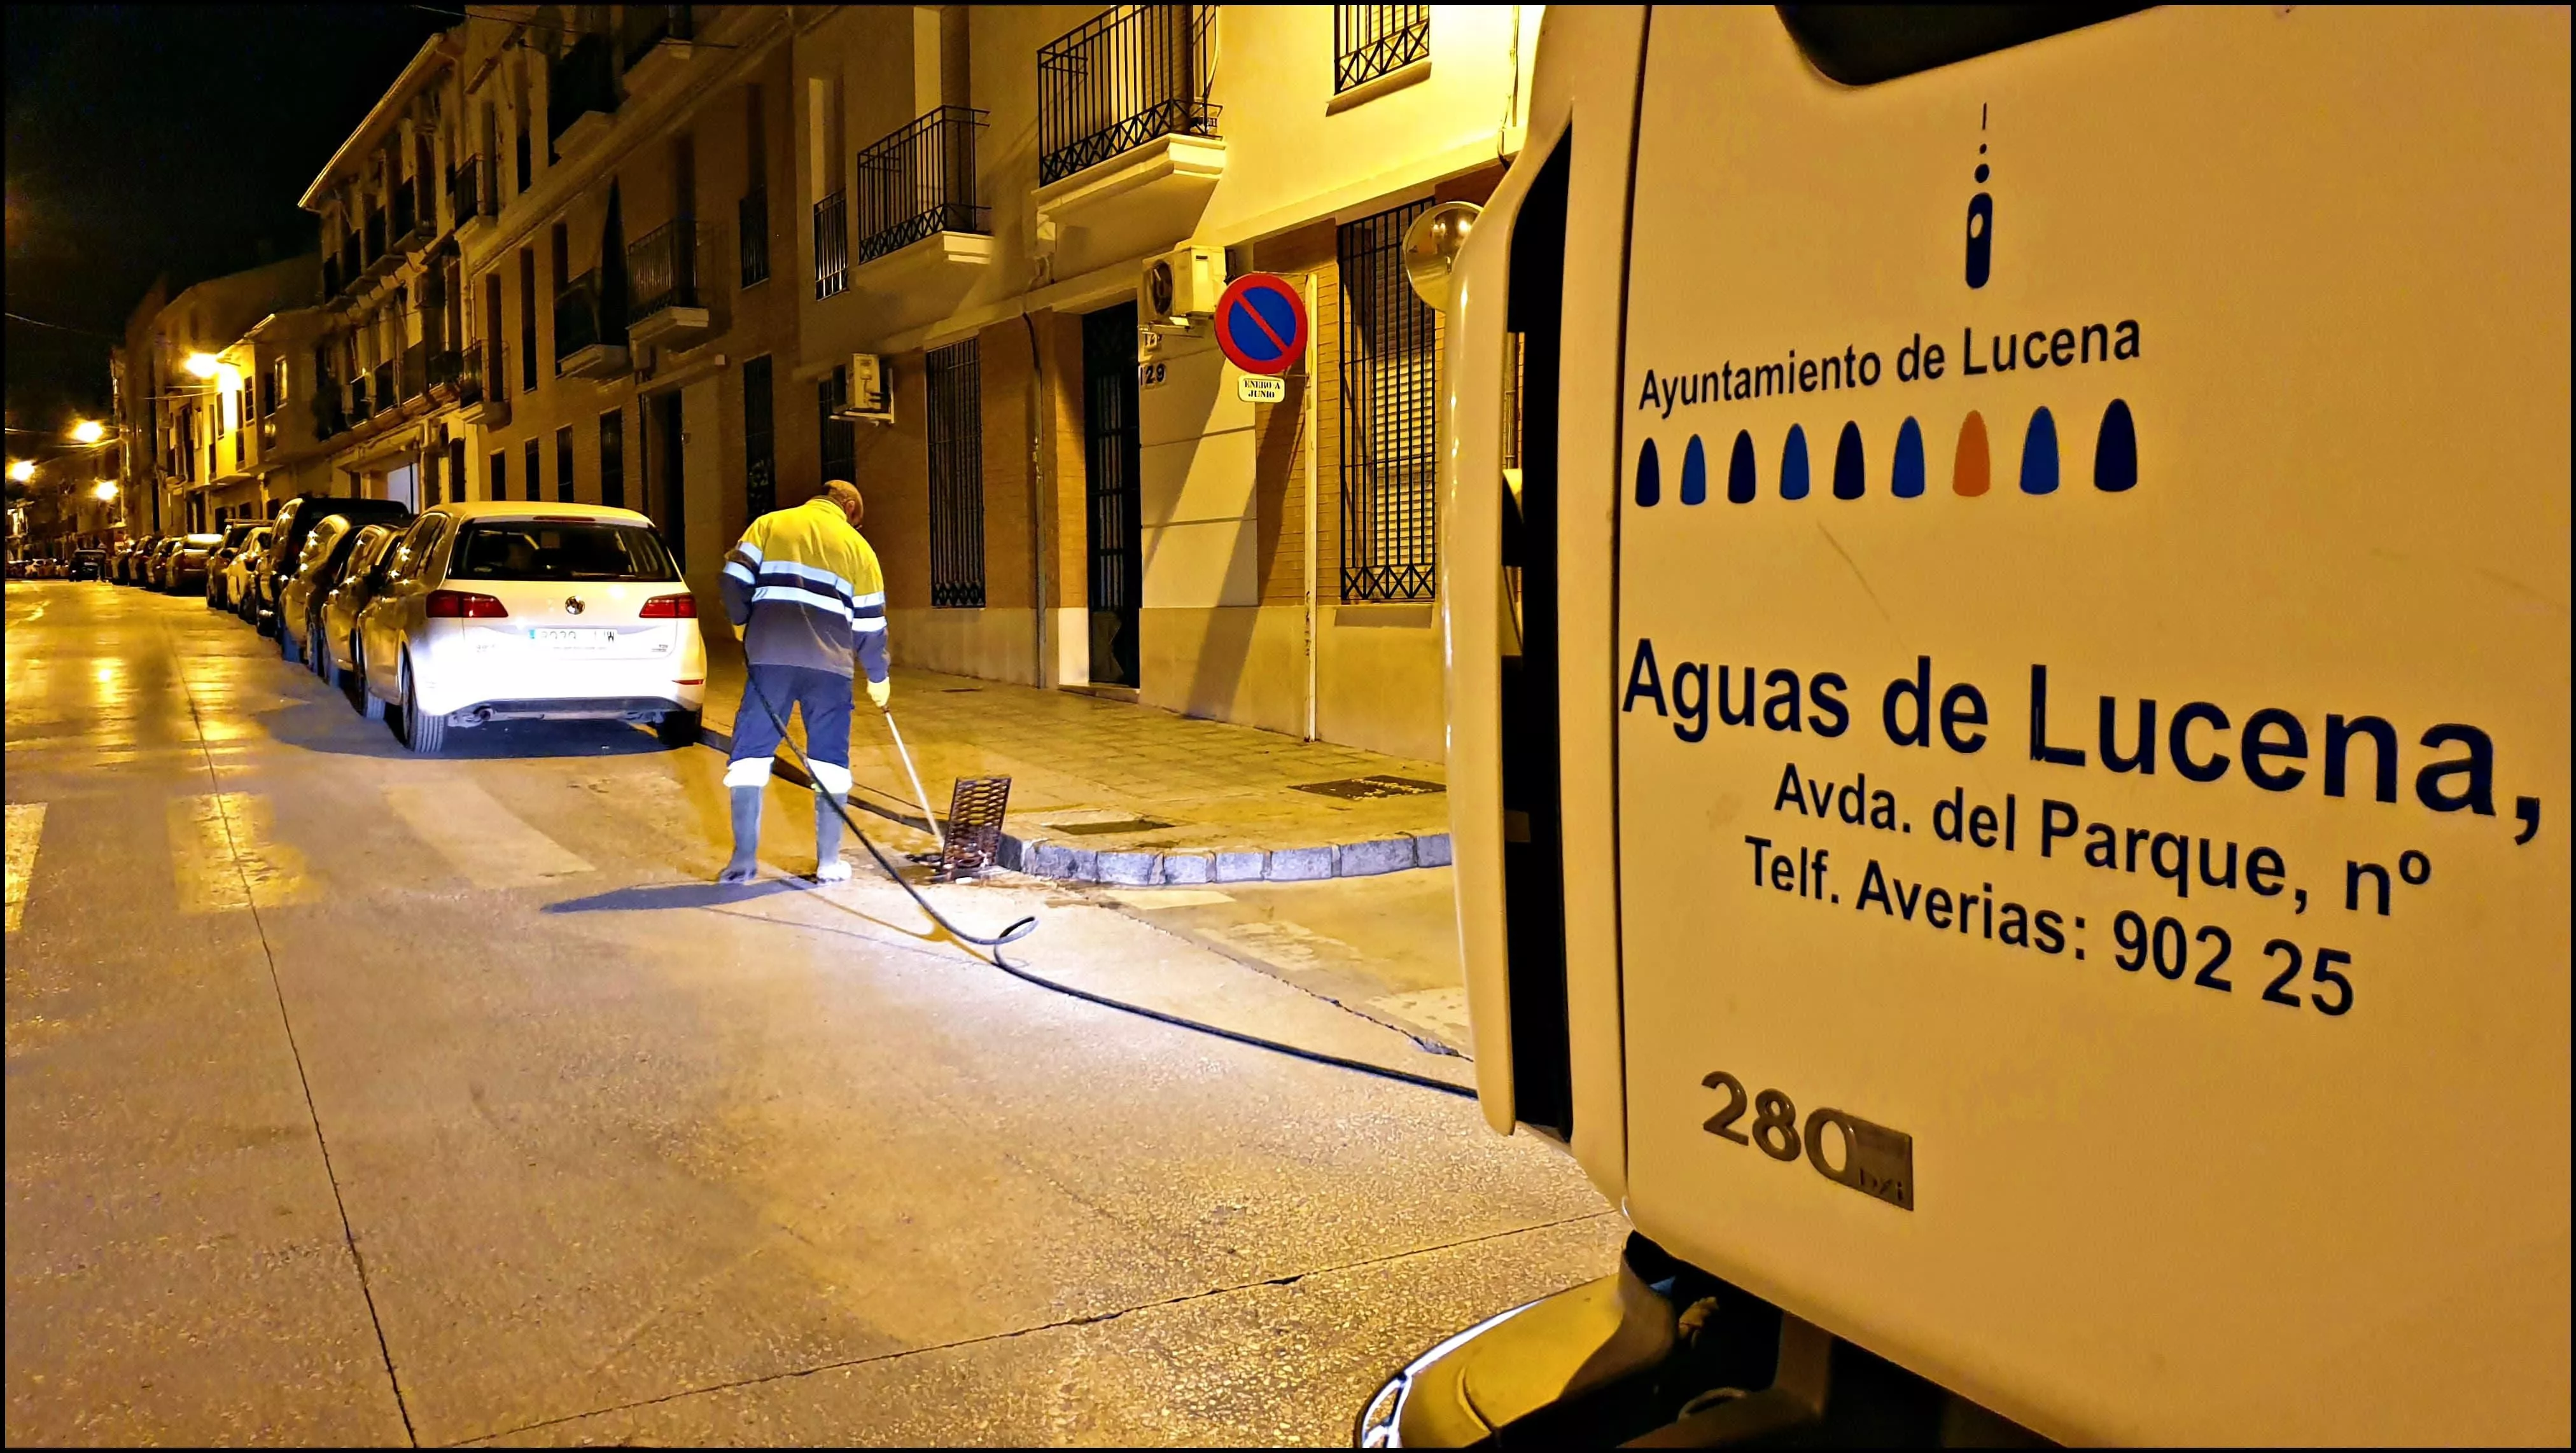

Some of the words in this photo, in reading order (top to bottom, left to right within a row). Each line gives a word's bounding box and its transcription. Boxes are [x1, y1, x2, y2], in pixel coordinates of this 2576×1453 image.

[1245, 380, 1271, 389] ENERO
[1638, 350, 1881, 419] Ayuntamiento
[1896, 333, 1945, 383] de
[1964, 319, 2141, 375] Lucena
[1622, 638, 1850, 743] Aguas
[1882, 655, 1989, 754] de
[2029, 664, 2544, 846] Lucena,
[1774, 763, 1911, 834] Avda.
[1932, 786, 2016, 852] del
[2041, 798, 2307, 915] Parque,
[1744, 835, 1839, 905] Telf.
[1855, 859, 2085, 961] Averias:
[2113, 910, 2232, 993] 902
[2261, 939, 2354, 1017] 25
[1702, 1071, 1856, 1186] 280
